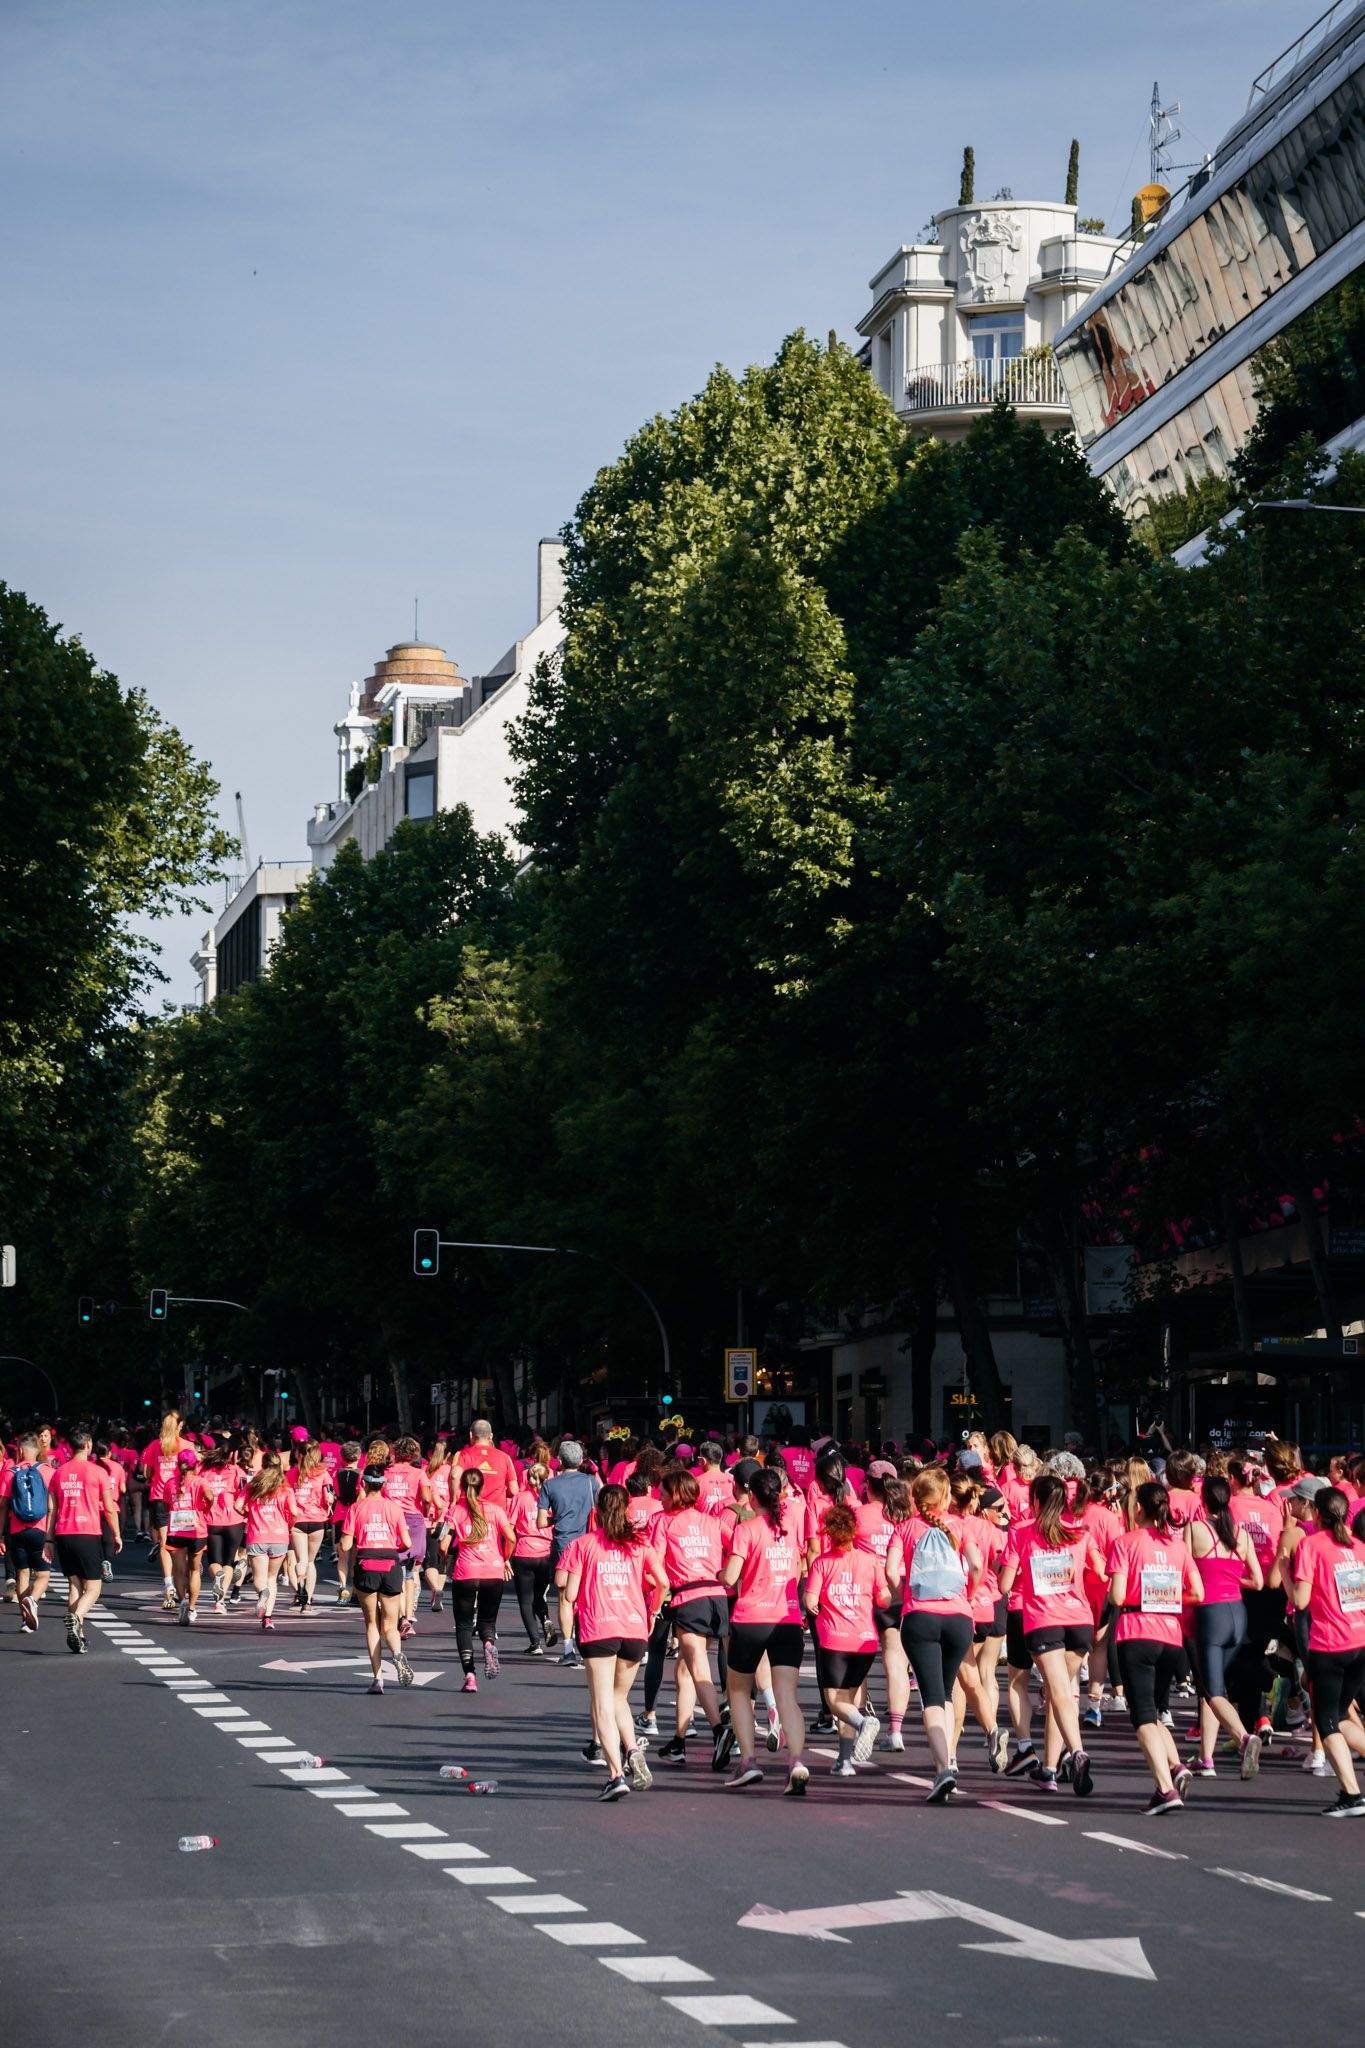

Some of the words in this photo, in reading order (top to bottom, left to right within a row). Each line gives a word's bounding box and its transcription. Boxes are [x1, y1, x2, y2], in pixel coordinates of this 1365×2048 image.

[1248, 1511, 1260, 1522] TU
[364, 1523, 390, 1531] DORSAL
[687, 1525, 700, 1535] TU
[366, 1531, 388, 1540] SUMA
[680, 1536, 711, 1547] DORSAL
[608, 1549, 621, 1561] TU
[684, 1547, 709, 1558] SUMA
[1154, 1550, 1167, 1564] TU
[1341, 1549, 1355, 1561] TU
[597, 1561, 632, 1574] DORSAL
[602, 1574, 628, 1585] SUMA
[840, 1572, 852, 1583] TU
[833, 1595, 860, 1607] SUMA
